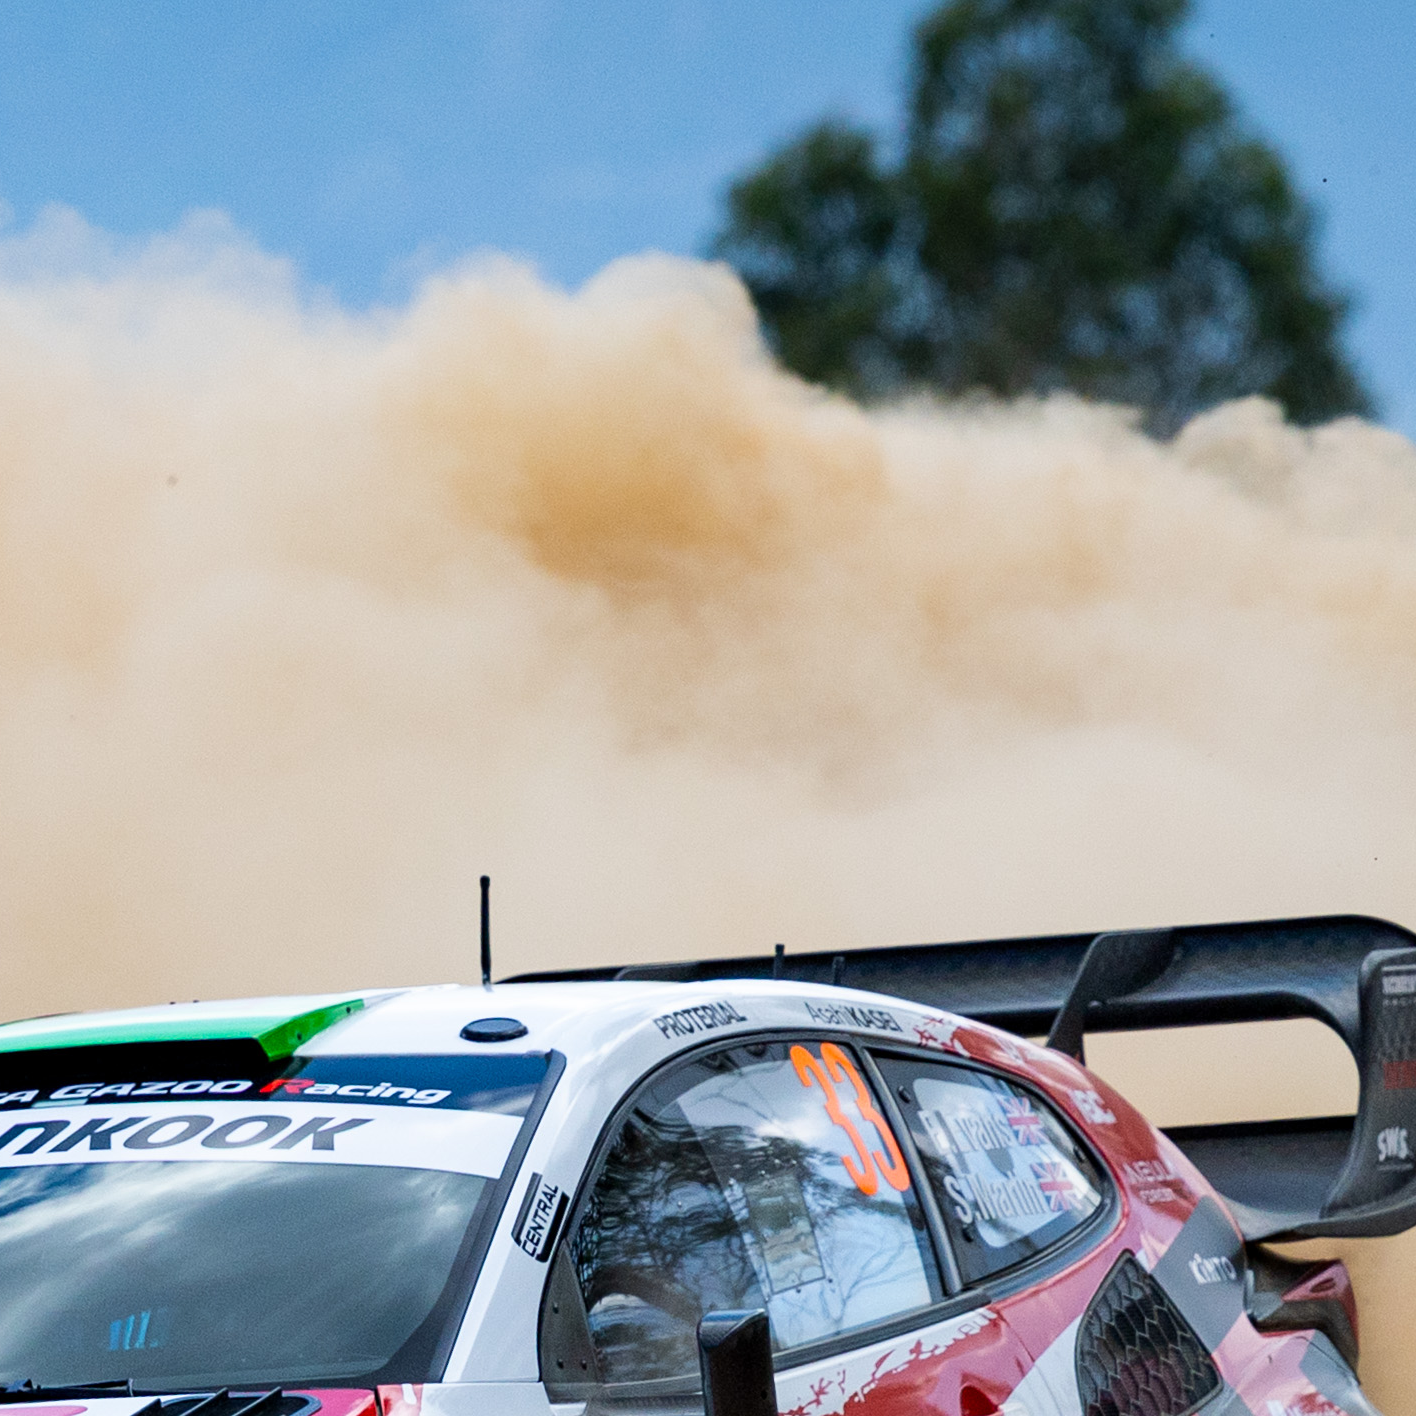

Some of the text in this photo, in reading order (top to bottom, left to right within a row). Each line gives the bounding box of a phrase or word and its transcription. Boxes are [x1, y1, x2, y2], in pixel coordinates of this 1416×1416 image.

[653, 1001, 748, 1039] PROTERIAL
[49, 1080, 253, 1101] GAZOO
[259, 1079, 452, 1105] Racing
[790, 1043, 910, 1197] 33
[521, 1183, 559, 1258] CENTRAL
